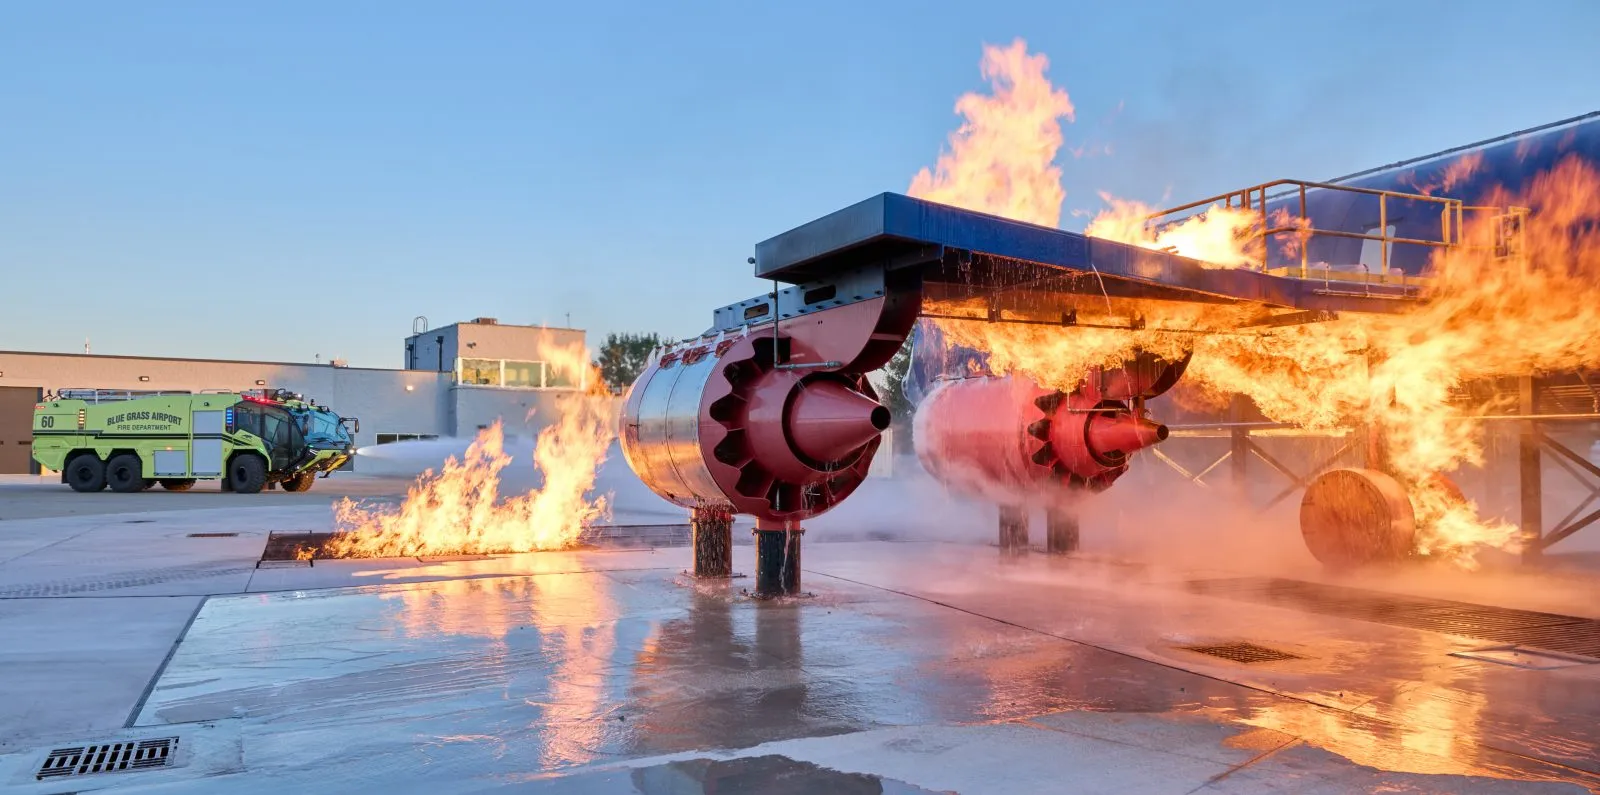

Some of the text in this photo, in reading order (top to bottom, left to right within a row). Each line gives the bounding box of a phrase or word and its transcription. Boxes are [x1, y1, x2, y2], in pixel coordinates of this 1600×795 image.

[41, 416, 54, 428] 60
[107, 412, 182, 426] BLUE GRASS AIRPORT
